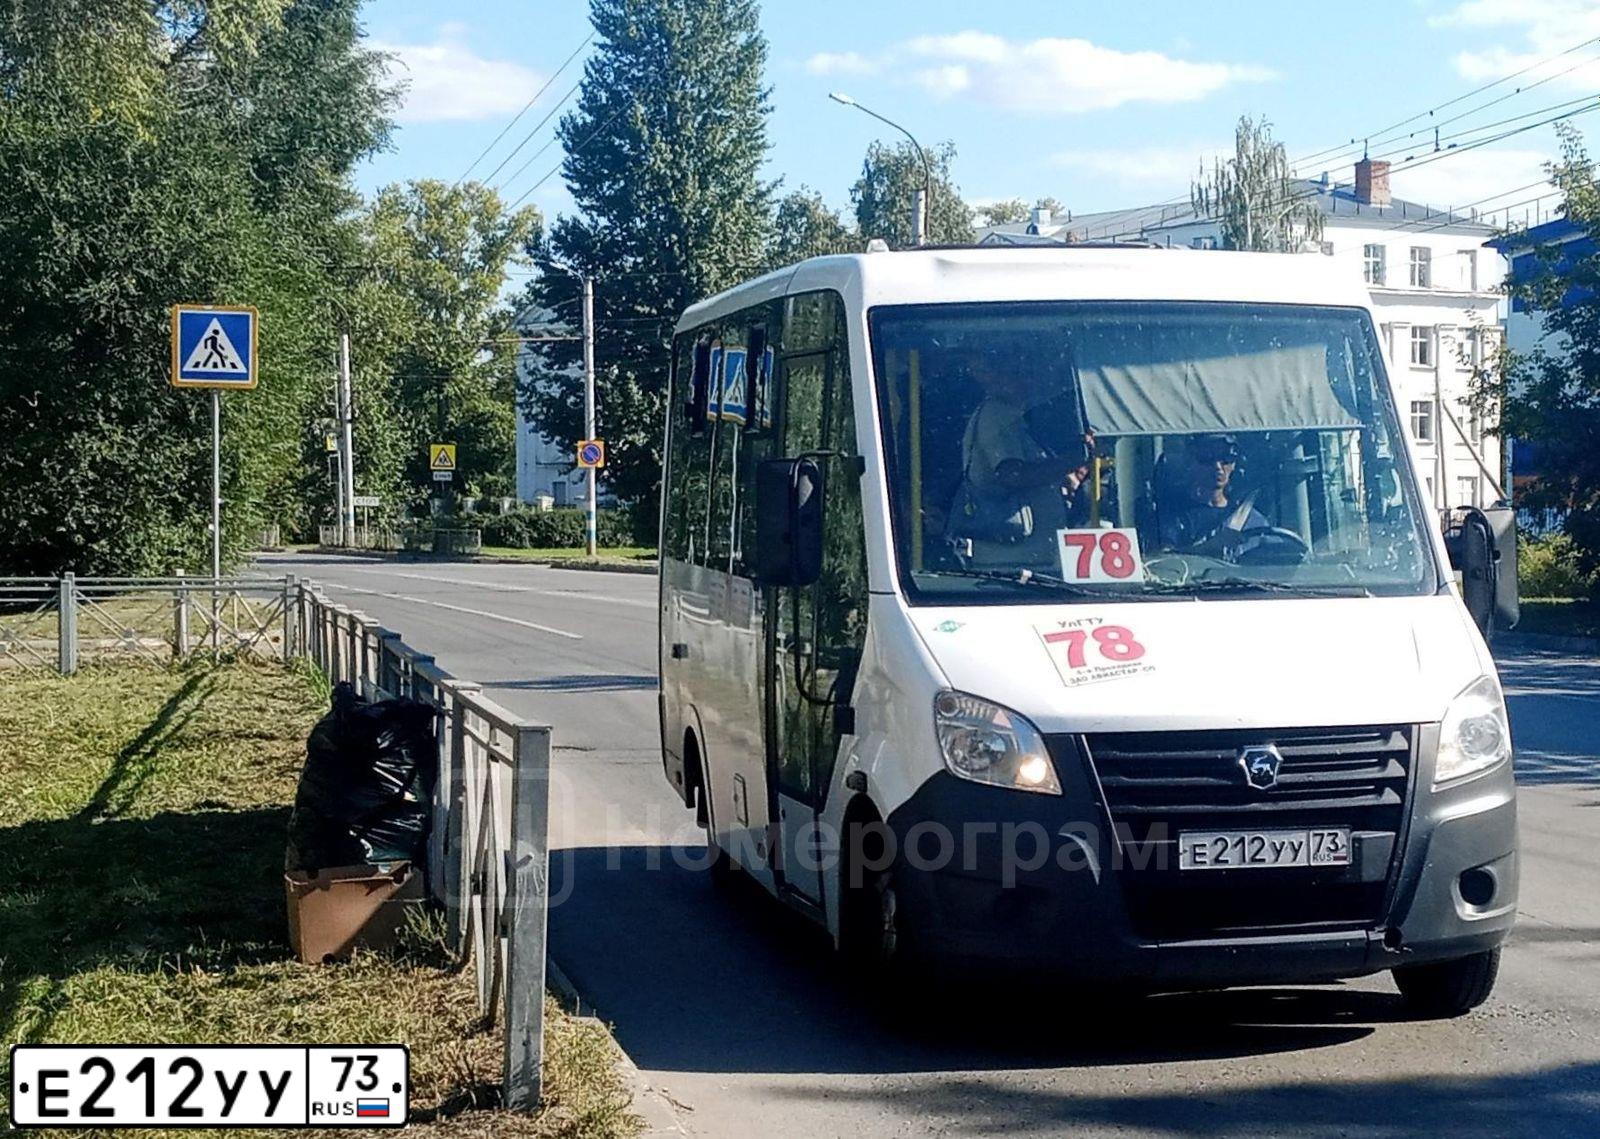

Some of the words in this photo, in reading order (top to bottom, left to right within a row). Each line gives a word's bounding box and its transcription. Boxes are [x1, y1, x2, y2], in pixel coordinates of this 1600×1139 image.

[1063, 531, 1136, 579] 78
[1043, 625, 1146, 669] 78
[1192, 834, 1304, 865] Е212УУ
[1312, 831, 1340, 854] 73
[1312, 852, 1332, 862] RUS
